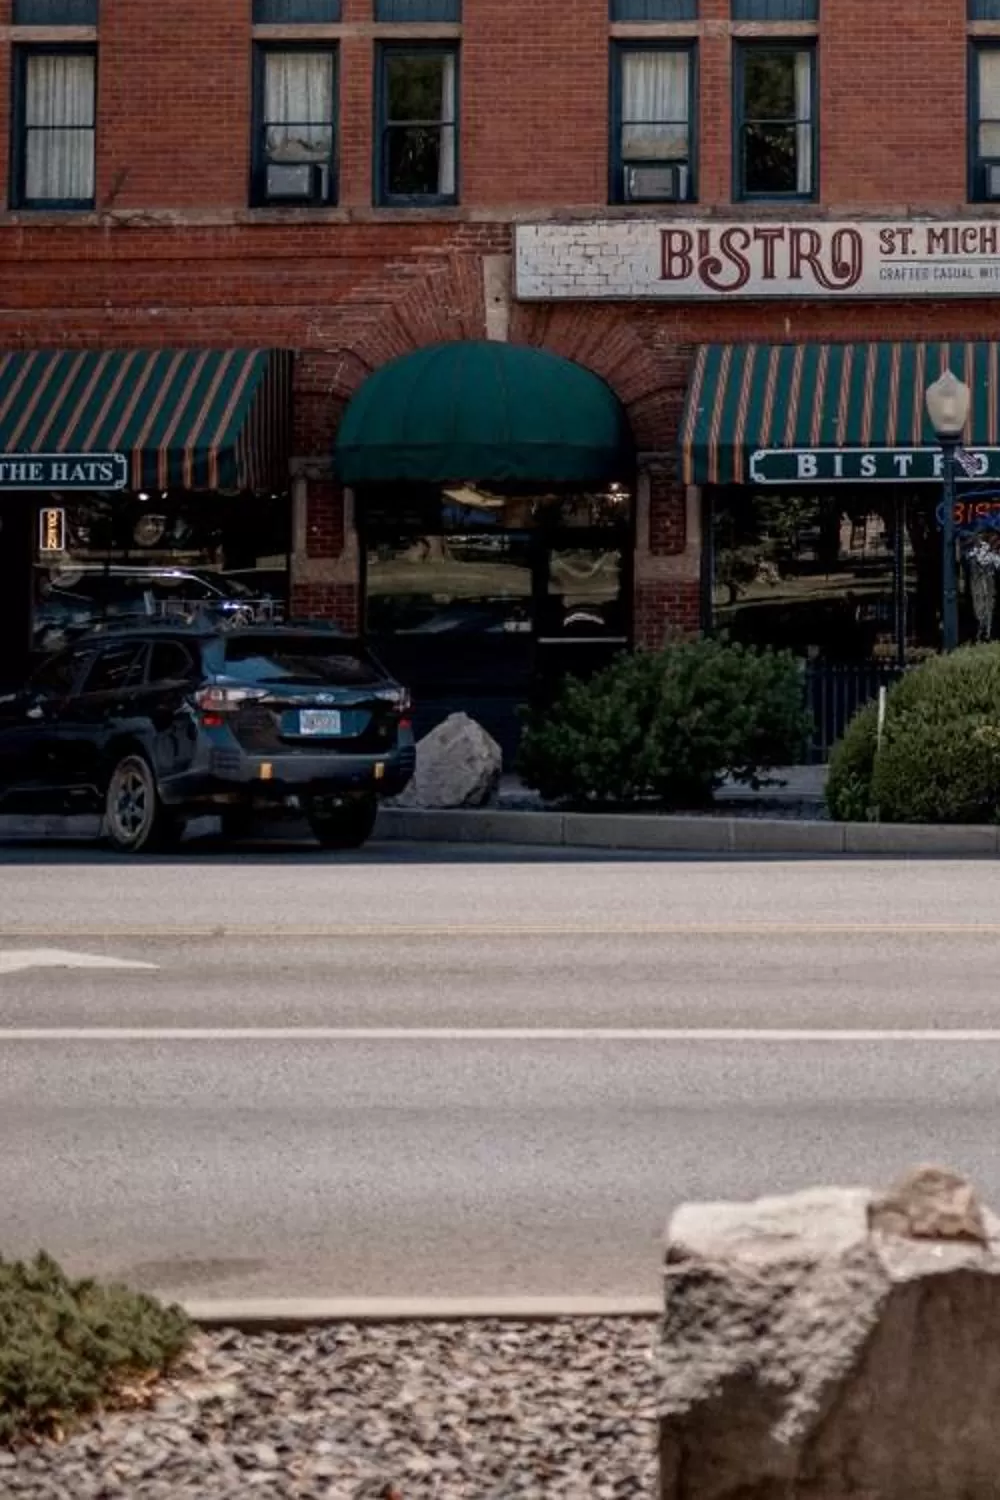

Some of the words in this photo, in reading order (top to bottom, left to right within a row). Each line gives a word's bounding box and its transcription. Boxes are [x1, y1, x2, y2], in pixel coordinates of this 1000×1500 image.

[879, 227, 917, 255] ST.
[659, 226, 863, 292] BISTRO
[879, 267, 929, 281] CRAFTED
[934, 266, 974, 280] CASUAL
[51, 462, 114, 481] HATS
